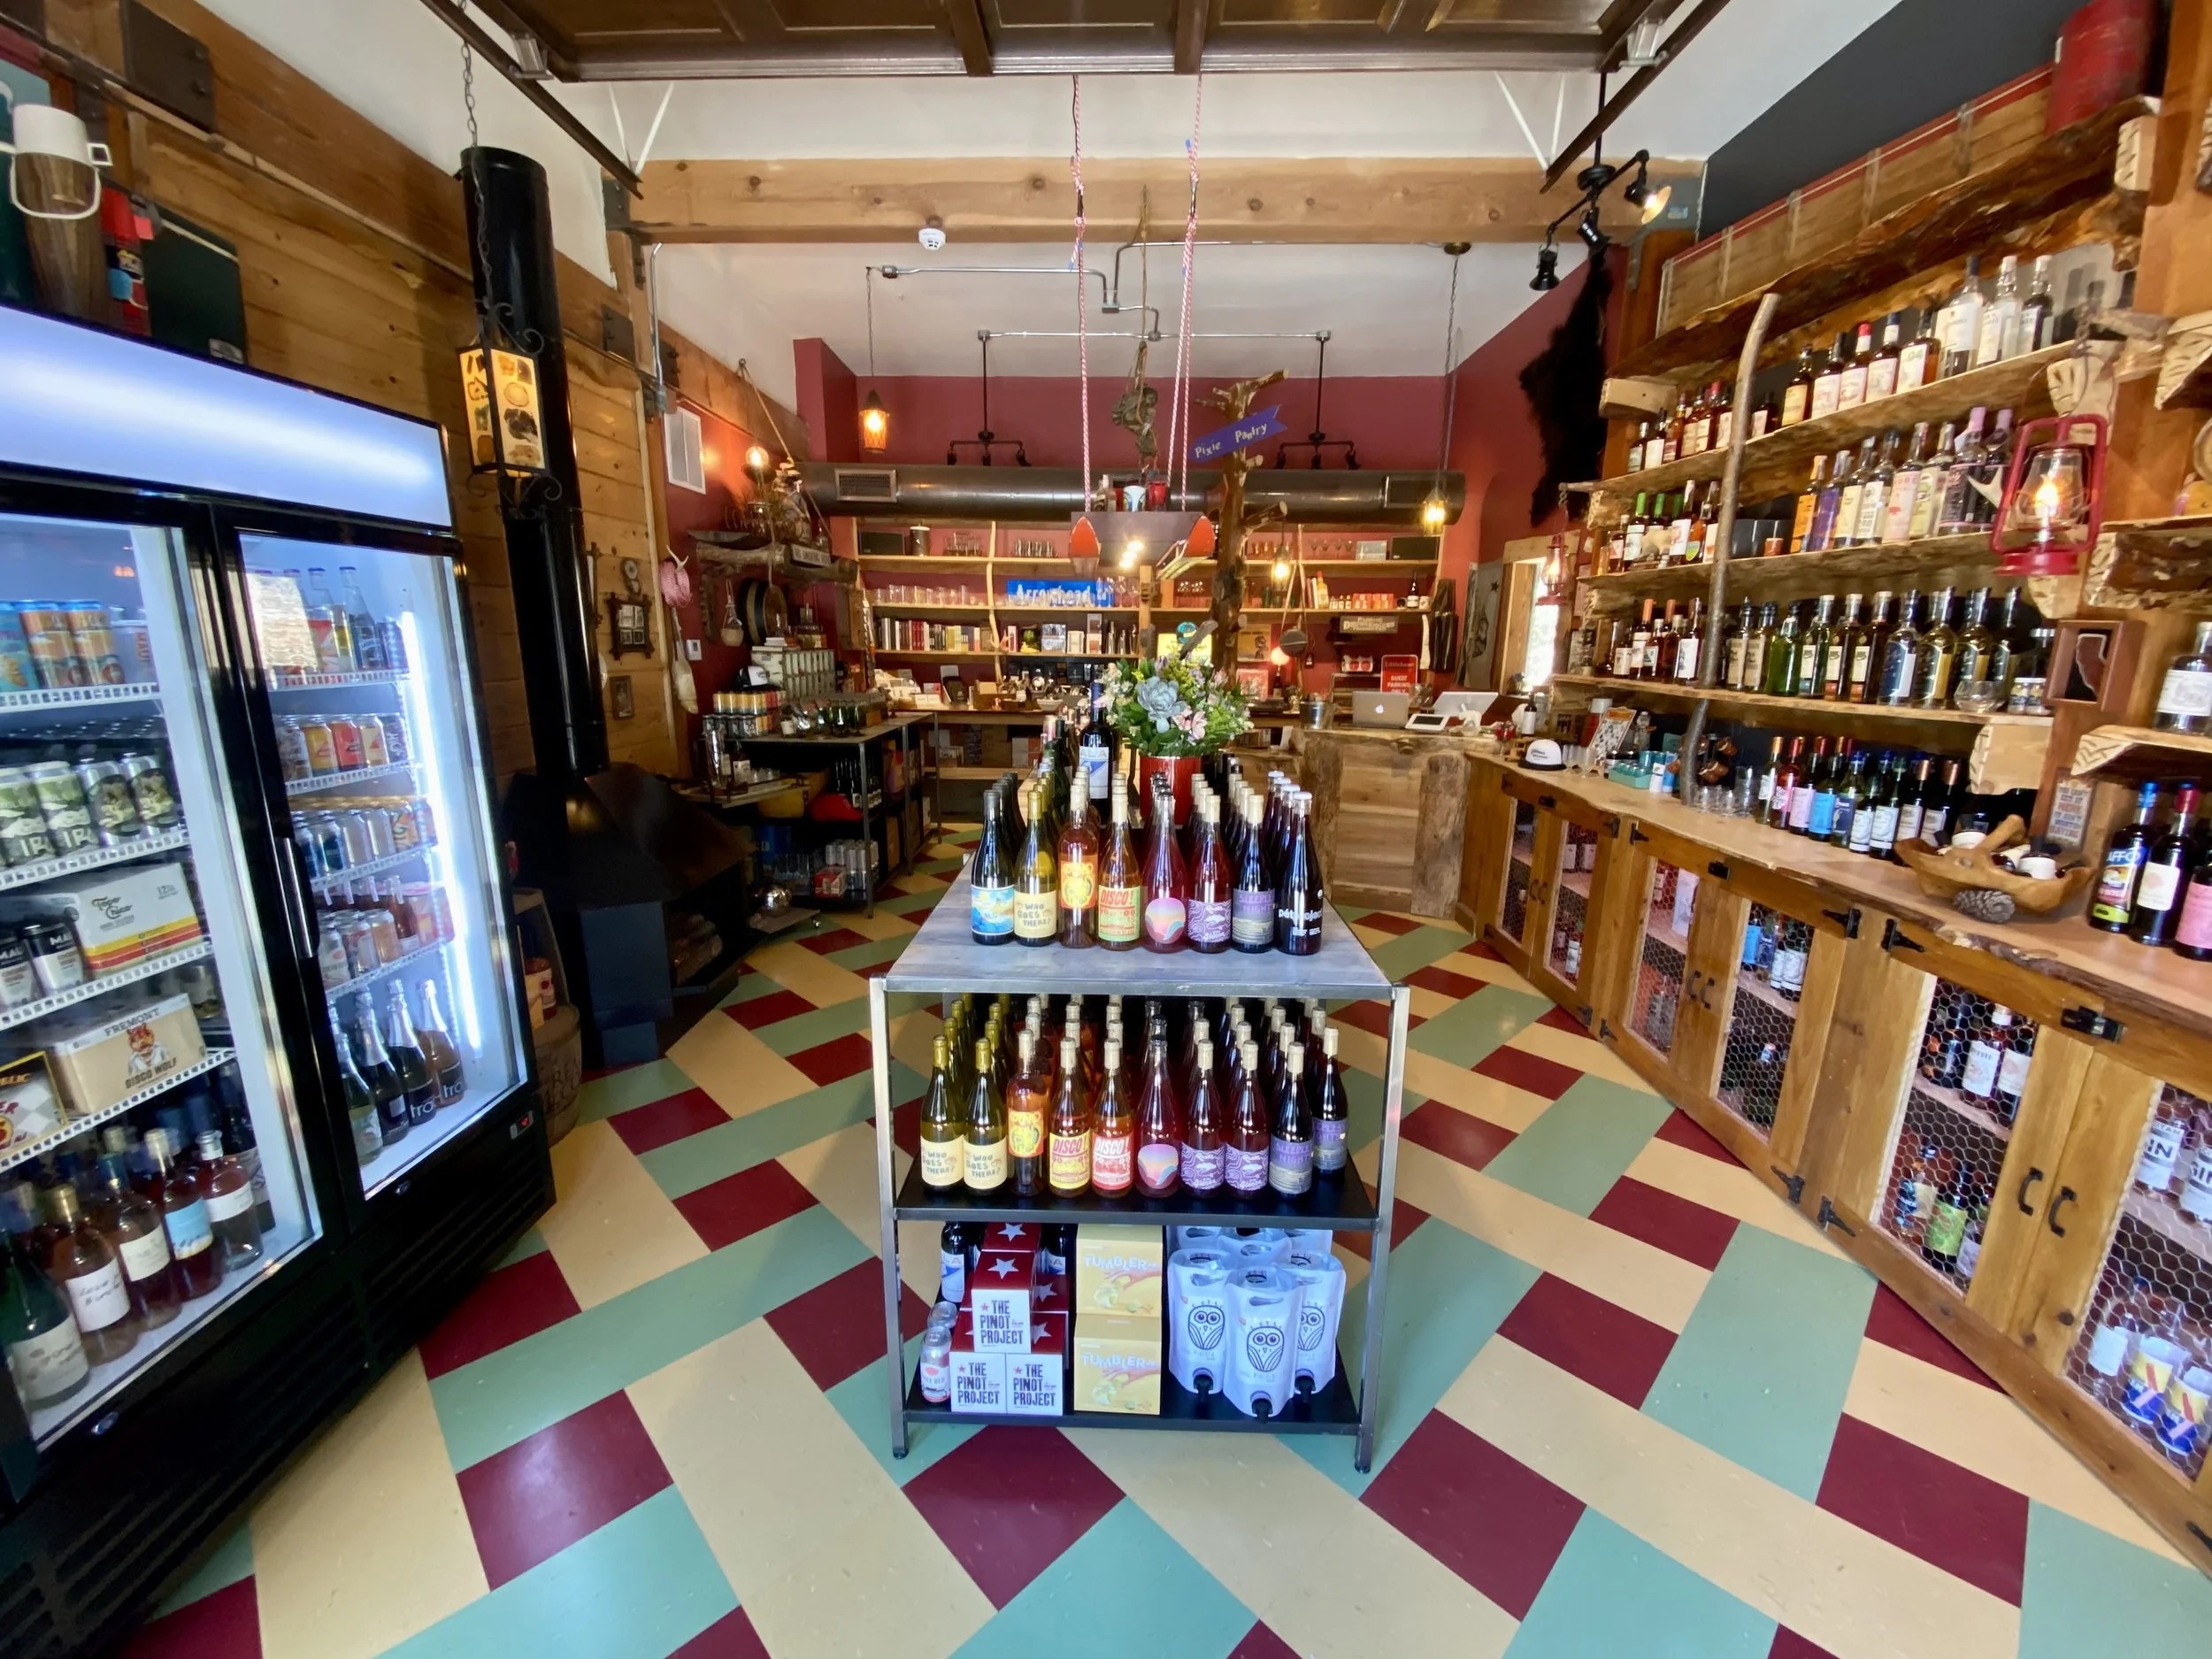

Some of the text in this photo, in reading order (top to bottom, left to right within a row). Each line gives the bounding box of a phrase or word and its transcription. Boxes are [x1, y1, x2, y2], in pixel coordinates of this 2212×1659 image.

[1194, 423, 1267, 458] Pixie Pantry
[91, 895, 121, 911] Topo
[105, 904, 134, 919] Chico
[104, 1008, 161, 1037] FREMONT
[125, 1057, 178, 1090] DISCO WOLF
[1095, 1136, 1129, 1155] DISCO!
[1083, 1256, 1148, 1271] TUMBLER
[992, 1300, 1010, 1314] THE
[979, 1315, 1010, 1329] PINOT
[981, 1330, 1024, 1344] PROJECT
[1081, 1354, 1146, 1370] TUMBLER
[969, 1363, 987, 1377] THE
[1025, 1363, 1043, 1378] THE
[956, 1376, 987, 1390] PINOT
[1013, 1378, 1043, 1392] PINOT
[958, 1390, 1000, 1404] PROJECT
[1013, 1392, 1056, 1406] PROJECT
